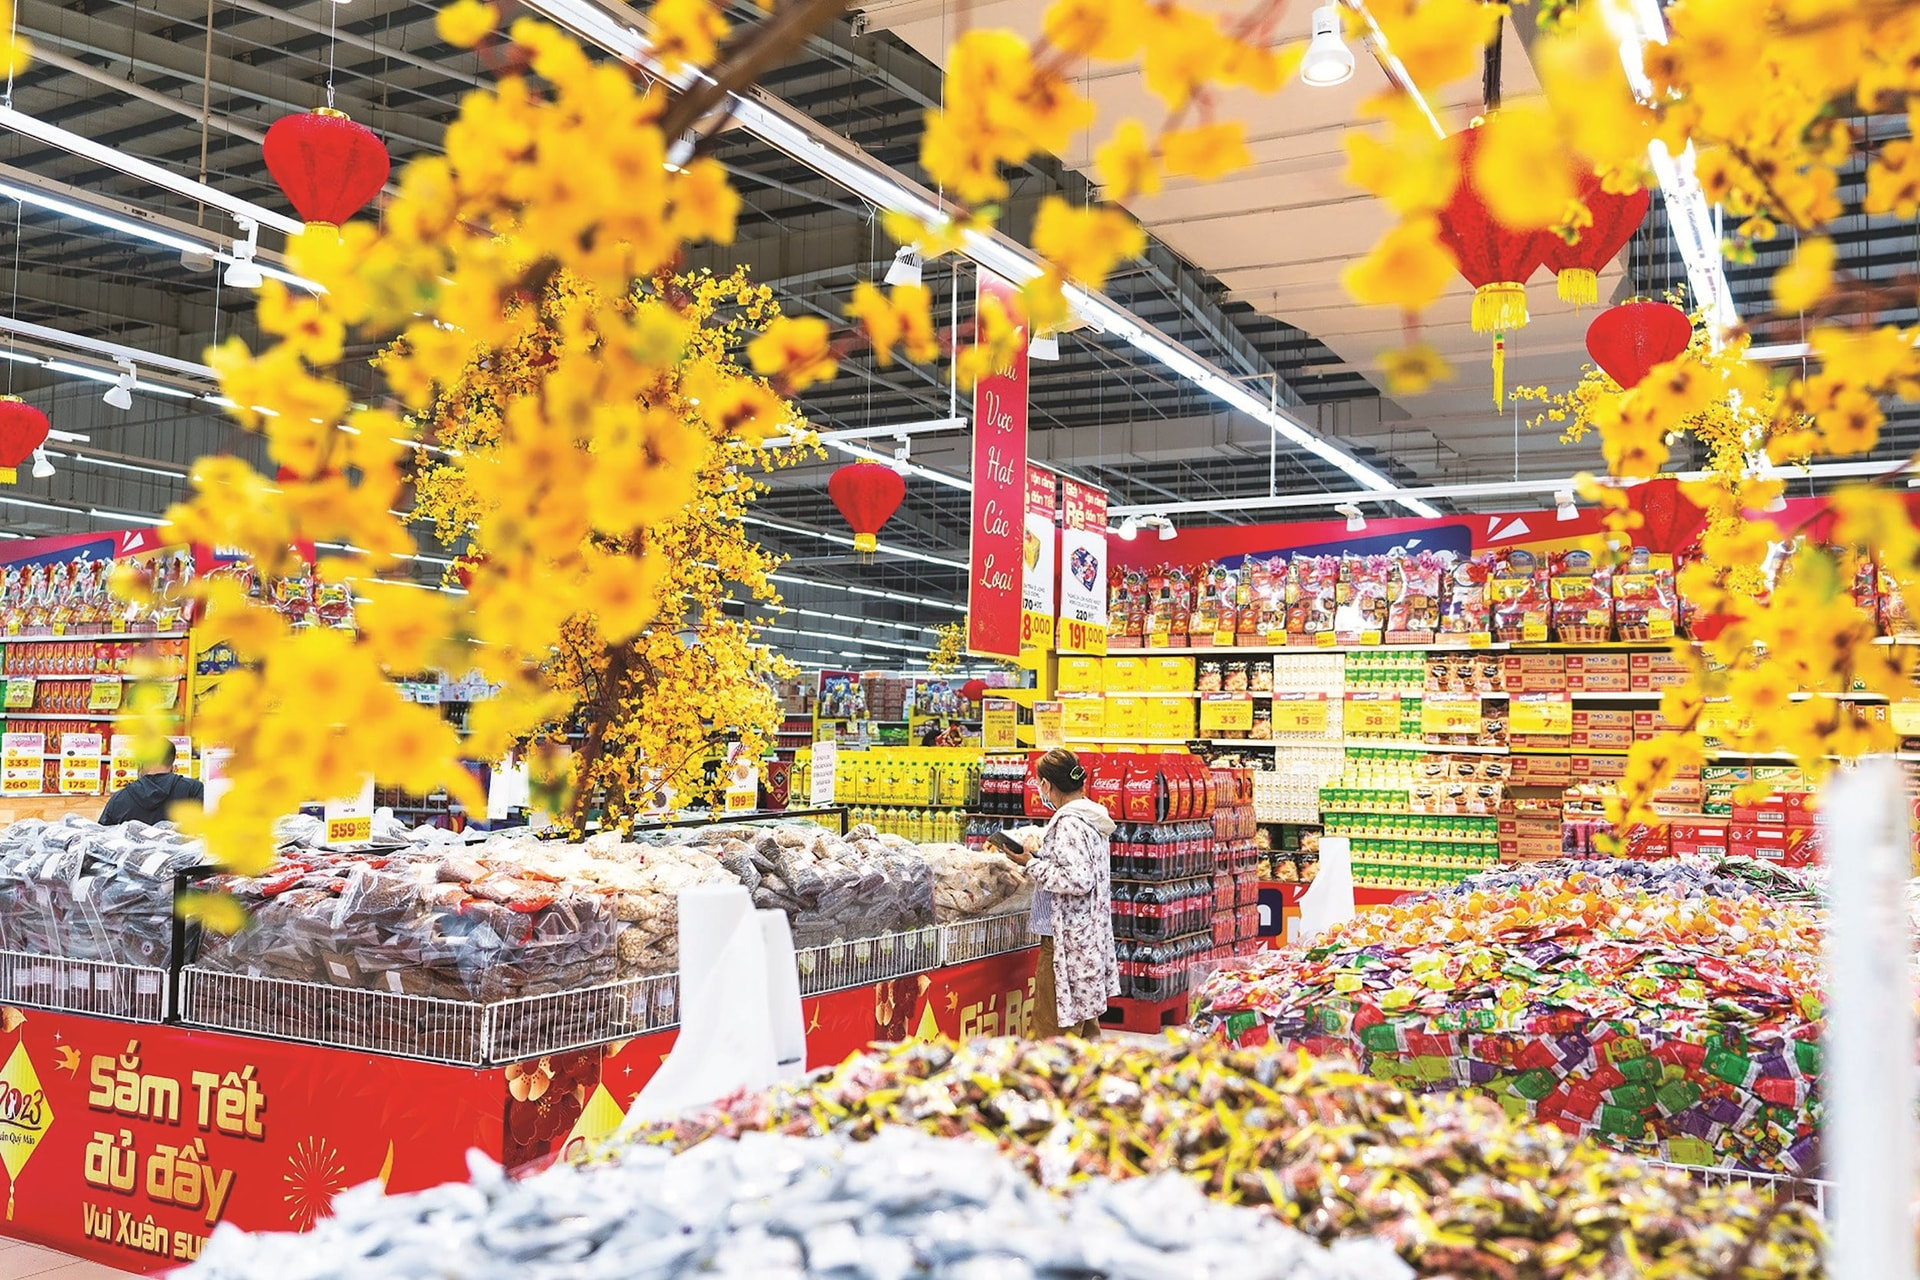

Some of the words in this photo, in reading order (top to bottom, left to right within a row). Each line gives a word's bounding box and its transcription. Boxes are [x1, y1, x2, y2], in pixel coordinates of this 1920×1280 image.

[986, 390, 1014, 434] Vực
[987, 446, 1014, 489] Hạt
[983, 500, 1010, 538] Các
[979, 554, 1014, 597] Loại
[1075, 712, 1089, 722] 75
[1221, 715, 1237, 724] 33
[1295, 716, 1309, 724] 15
[1365, 717, 1383, 725] 58
[1446, 717, 1462, 726] 91
[1543, 718, 1552, 728] 7
[7, 759, 29, 768] 333
[69, 759, 87, 768] 125
[5, 781, 28, 789] 260
[68, 781, 86, 789] 175
[731, 795, 746, 807] 199
[330, 822, 355, 839] 559
[88, 1039, 180, 1122] Sắm
[191, 1064, 266, 1138] Tết
[84, 1128, 137, 1192] đủ
[146, 1137, 233, 1222] đầy
[82, 1201, 112, 1241] Vui
[115, 1209, 169, 1255] Xuân
